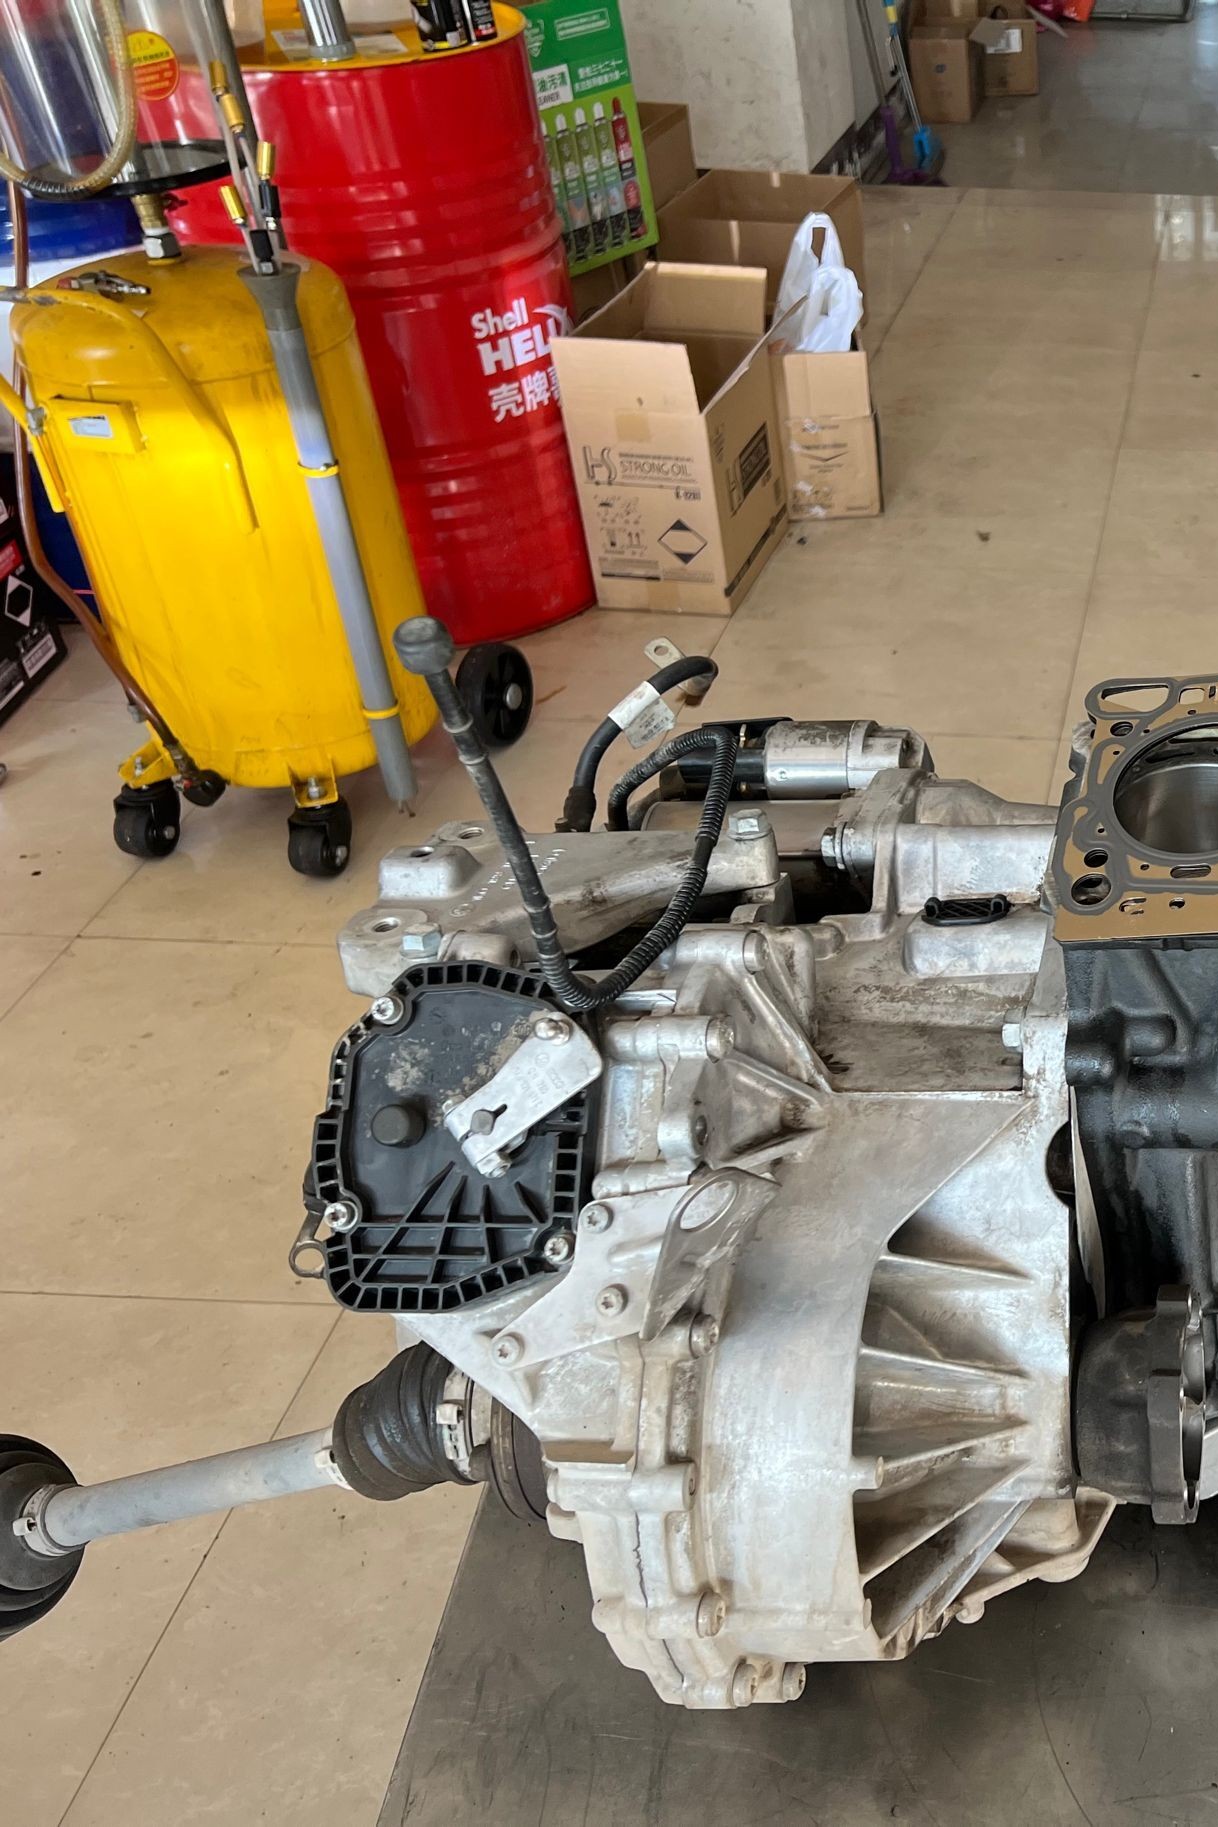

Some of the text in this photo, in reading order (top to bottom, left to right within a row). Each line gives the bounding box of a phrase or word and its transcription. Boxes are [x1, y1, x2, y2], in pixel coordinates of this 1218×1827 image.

[471, 297, 529, 339] Shell
[620, 460, 693, 477] STRONG OIL
